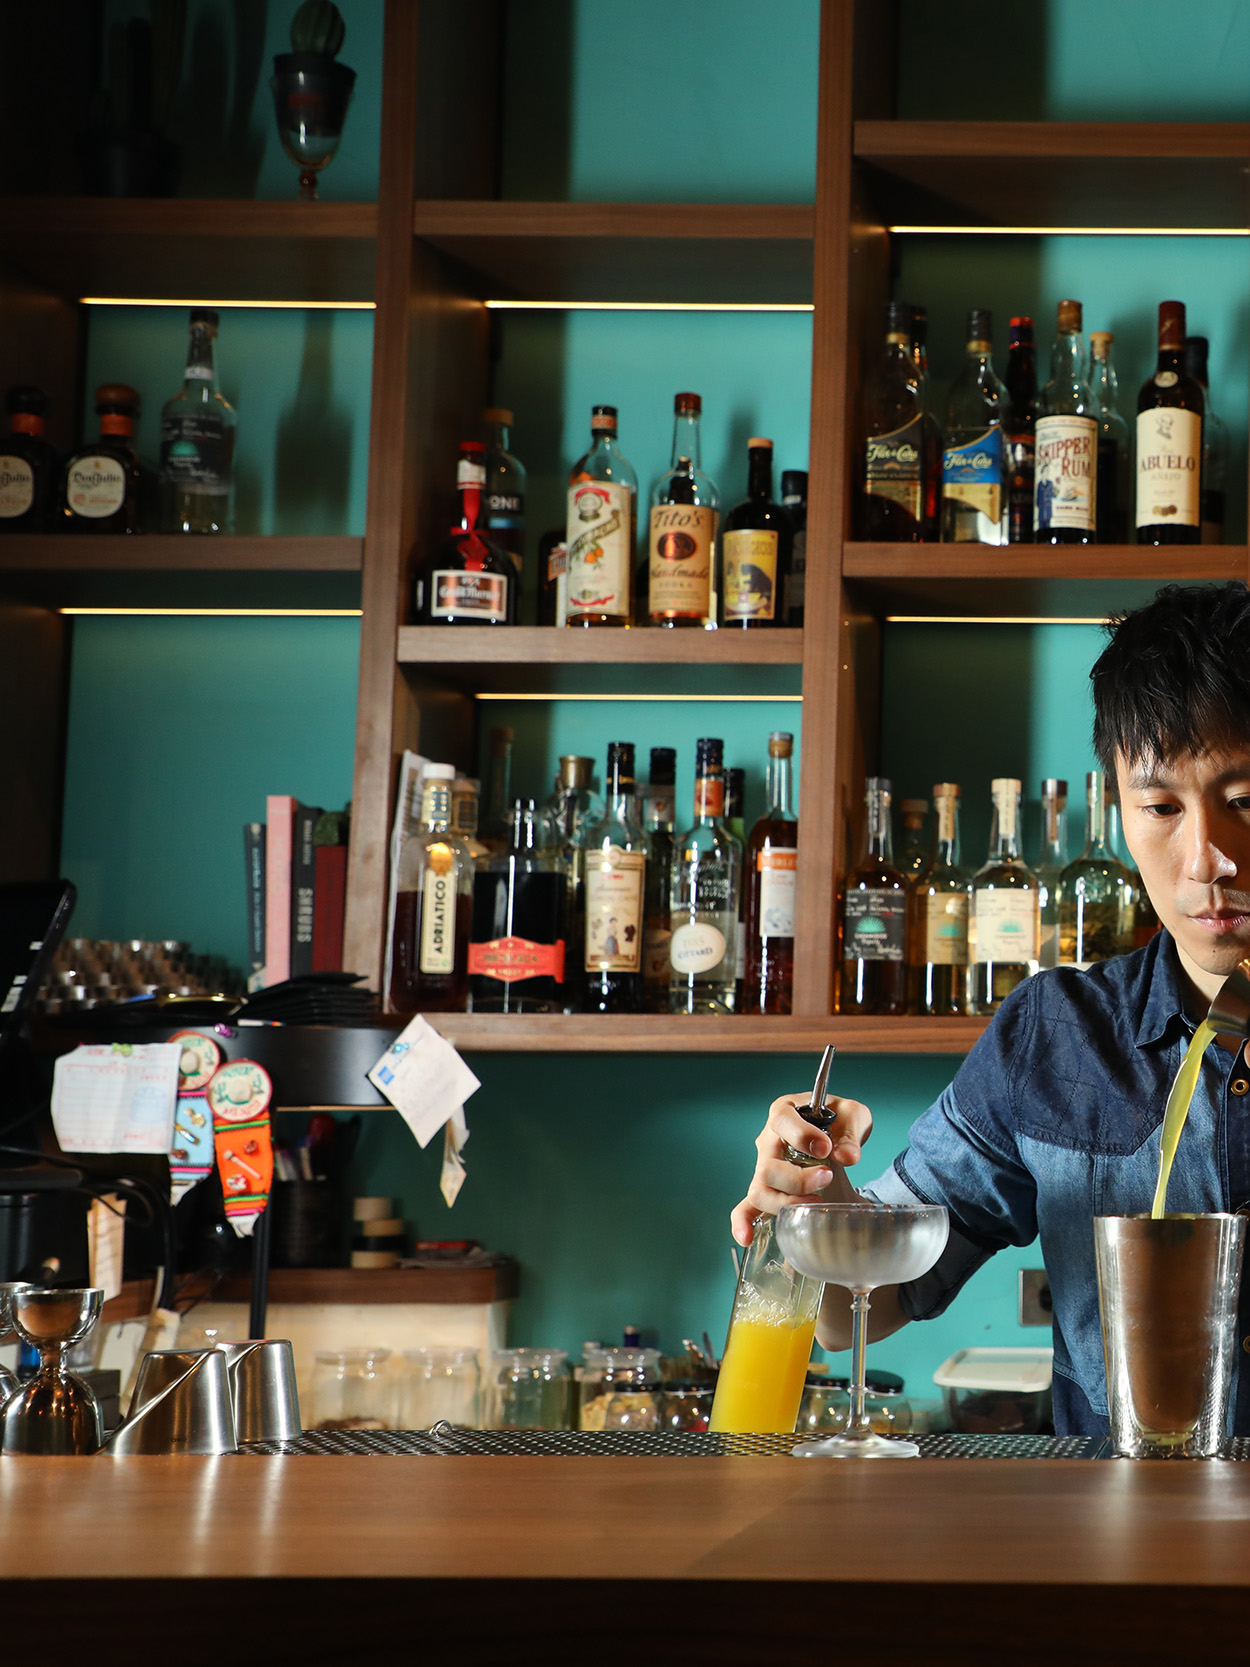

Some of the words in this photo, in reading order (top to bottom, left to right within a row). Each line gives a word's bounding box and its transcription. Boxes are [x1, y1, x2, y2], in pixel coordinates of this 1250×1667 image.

[1037, 436, 1091, 465] SKIPPER
[1061, 457, 1091, 478] RUM
[1139, 455, 1196, 473] ABUELO
[653, 510, 704, 529] Tito's
[297, 887, 313, 943] SHRUBS
[433, 880, 446, 955] ADRIATICO
